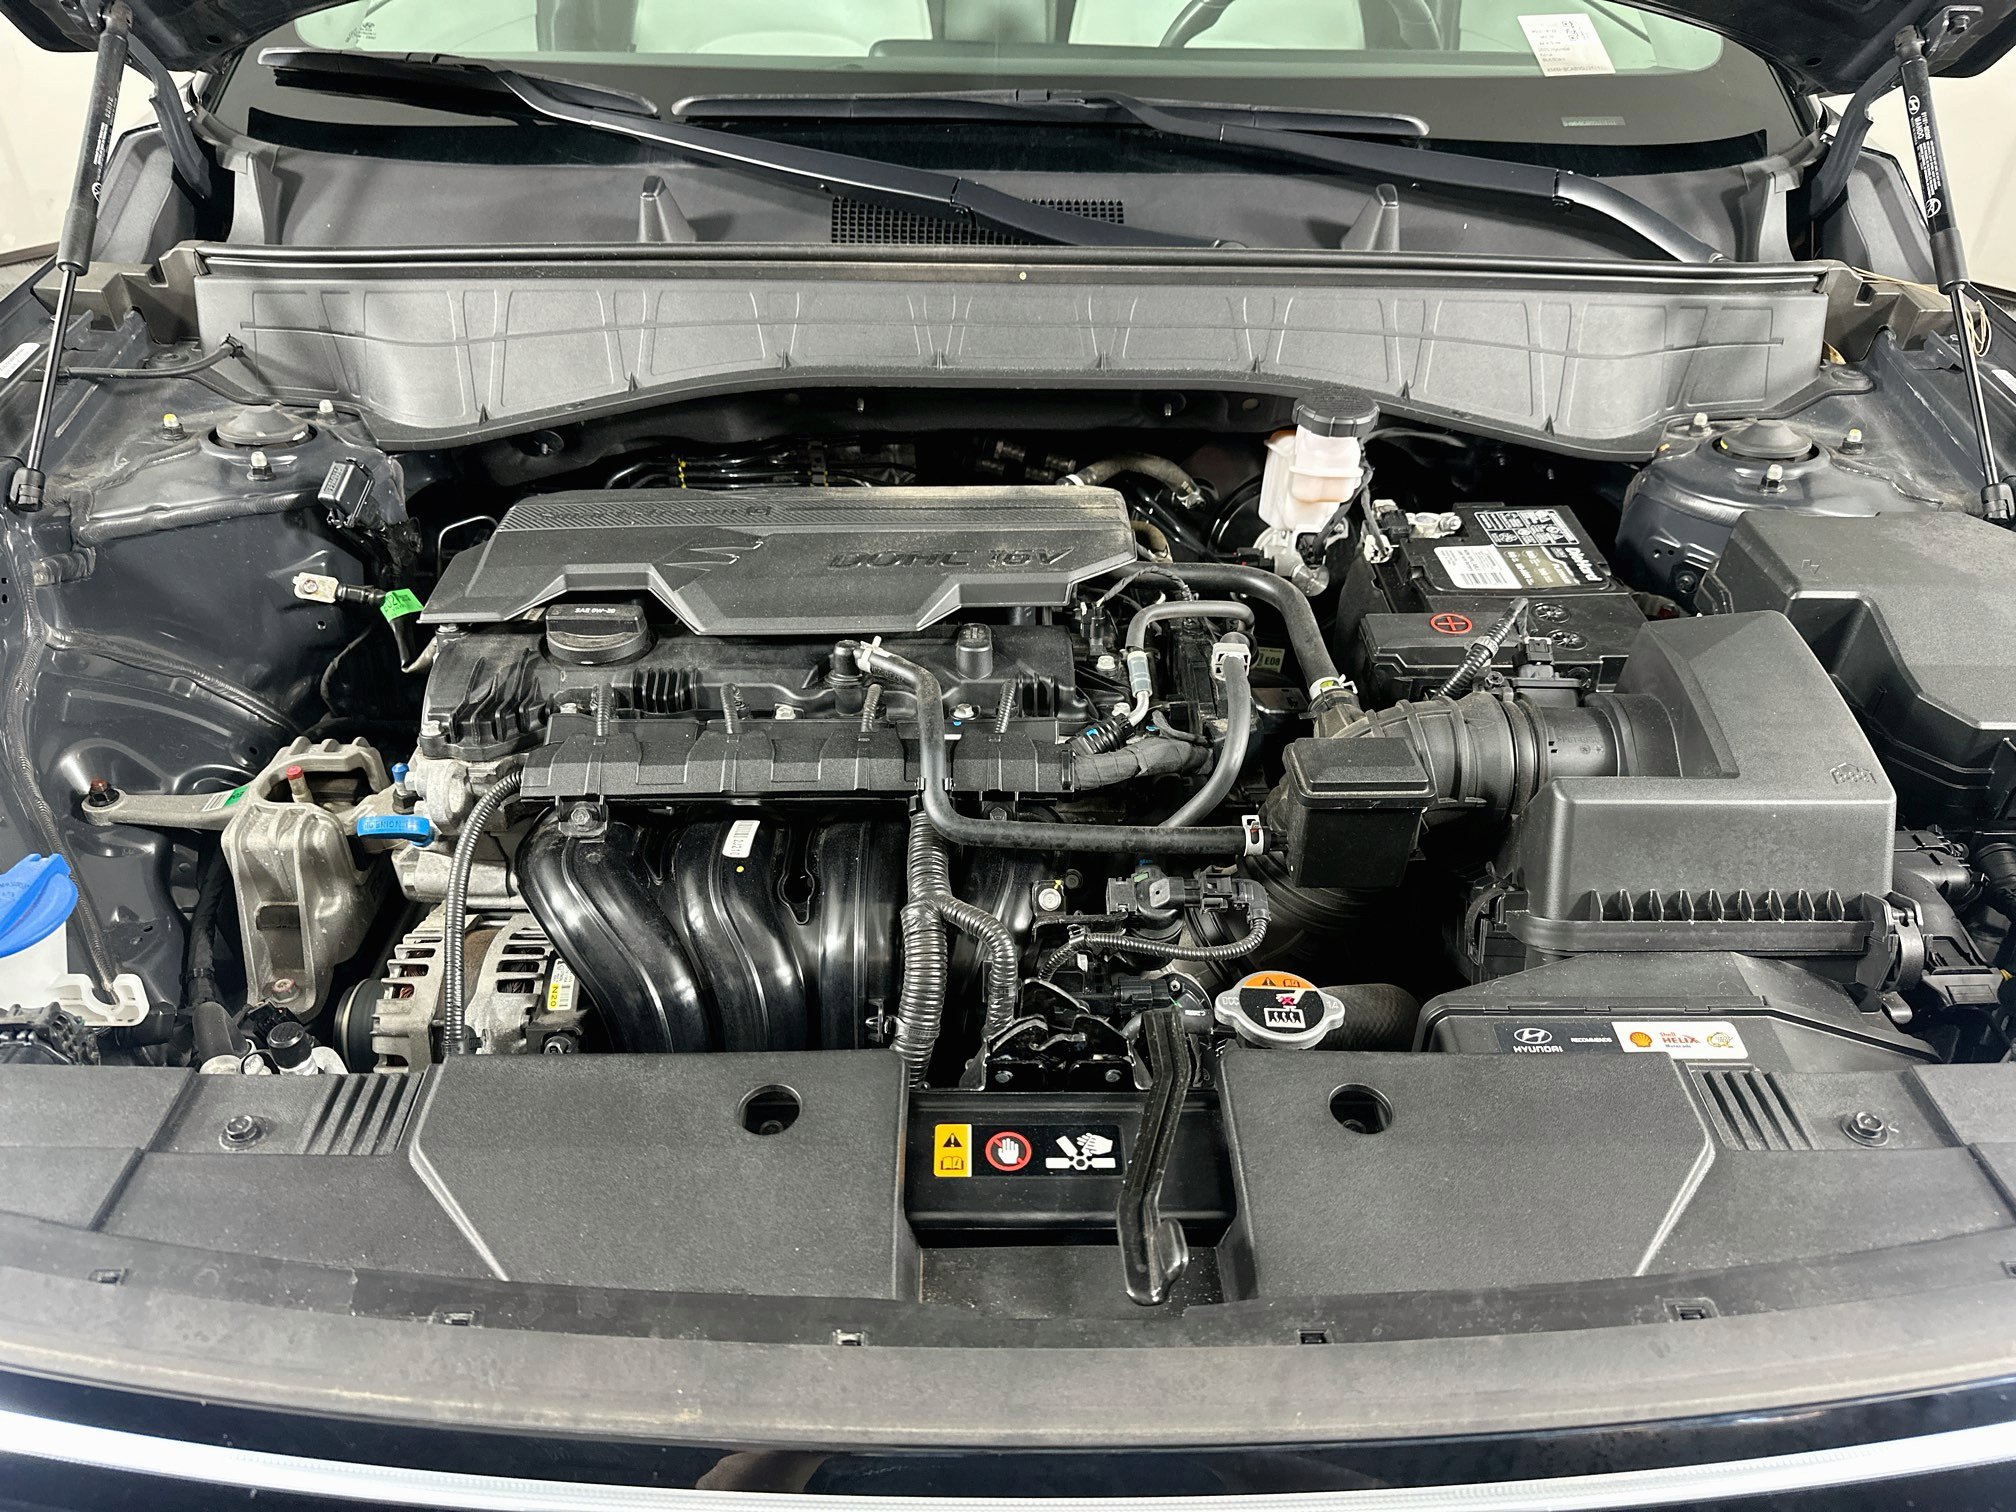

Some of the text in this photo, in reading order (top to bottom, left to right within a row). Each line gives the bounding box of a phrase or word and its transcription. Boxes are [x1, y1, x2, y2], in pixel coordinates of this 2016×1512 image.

[828, 549, 976, 569] DOHC
[1564, 547, 1603, 582] DieHard
[550, 985, 559, 1008] N20
[1513, 1045, 1564, 1054] HYUNDAI
[1661, 1036, 1697, 1044] HELIX
